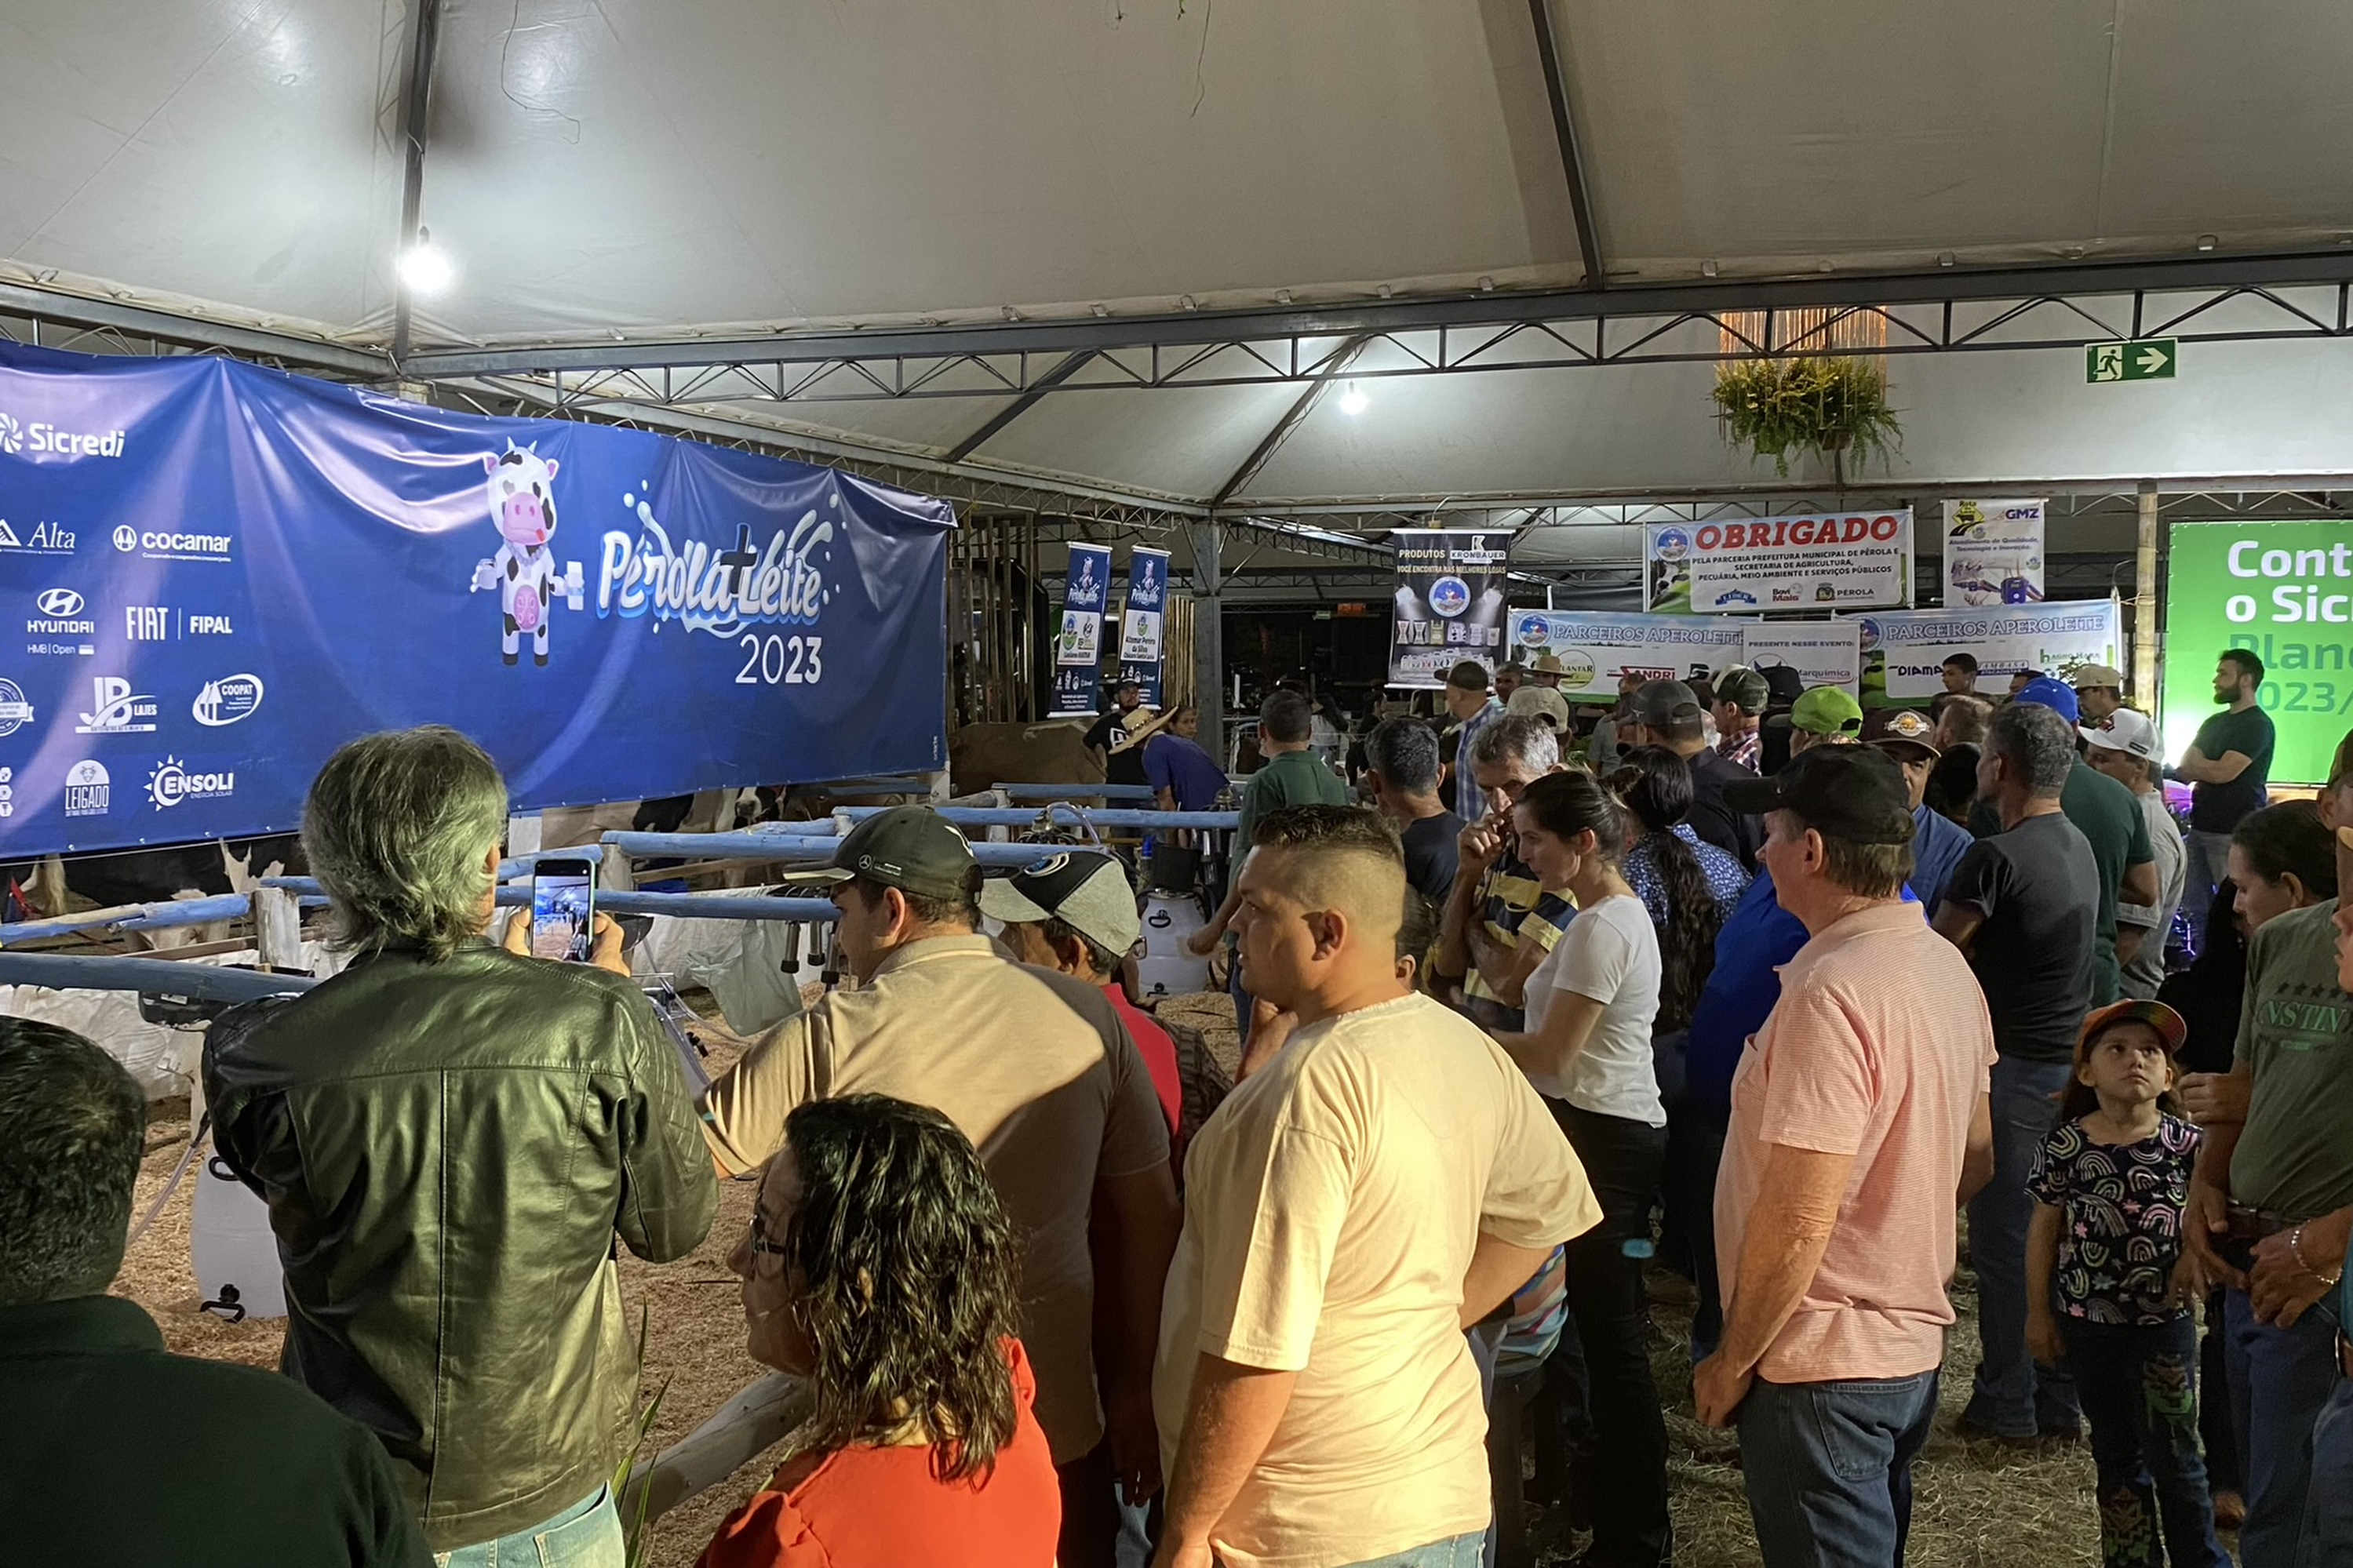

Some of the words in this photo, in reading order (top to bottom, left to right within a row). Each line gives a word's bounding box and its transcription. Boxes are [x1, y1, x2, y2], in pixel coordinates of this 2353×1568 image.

[29, 424, 126, 457] Sicredi
[2005, 508, 2039, 519] GMZ
[27, 521, 76, 549] Alta
[142, 532, 231, 552] cocamar
[1695, 515, 1899, 551] OBRIGADO
[1399, 550, 1445, 558] PRODUTOS
[1752, 553, 1800, 562] PREFEITURA
[1801, 551, 1845, 559] MUNICIPAL
[1859, 547, 1892, 556] PÉROLA
[1735, 562, 1782, 571] SECRETARIA
[1795, 559, 1854, 568] AGRICULTURA,
[1762, 570, 1803, 579] AMBIENTE
[1811, 568, 1850, 577] SERVIÇOS
[1852, 565, 1892, 573] PÚBLICOS
[2225, 595, 2257, 623] o
[27, 620, 94, 634] HYUNDAI
[126, 606, 169, 640] FIAT
[190, 616, 232, 634] FIPAL
[1554, 624, 1643, 641] PARCEIROS
[1886, 620, 1987, 640] PARCEIROS
[1989, 615, 2104, 635] APEROLEITE
[736, 634, 822, 684] 2023
